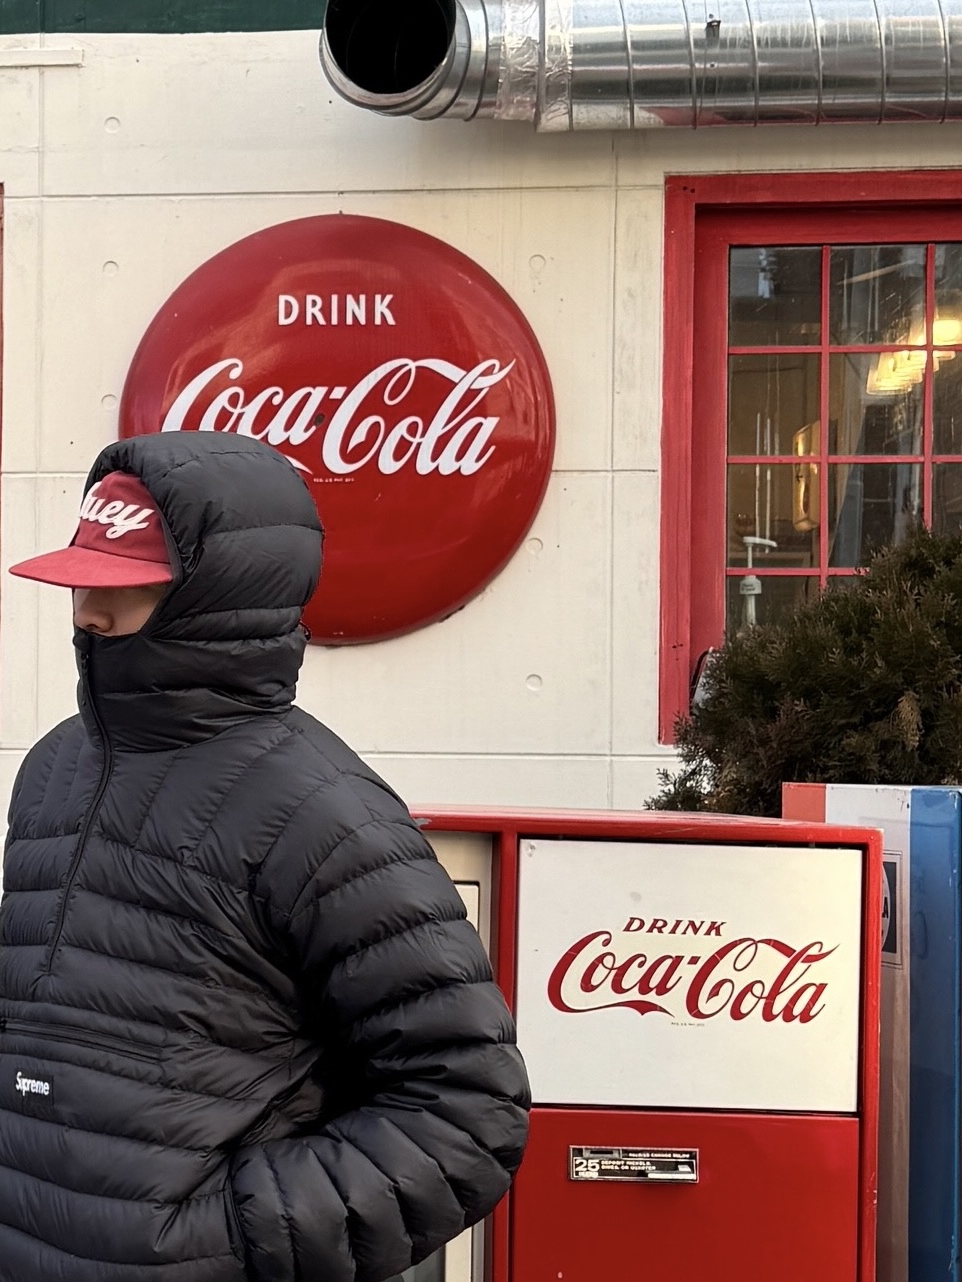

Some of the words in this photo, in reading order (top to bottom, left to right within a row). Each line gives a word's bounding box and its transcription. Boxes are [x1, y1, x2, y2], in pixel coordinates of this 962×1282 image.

[278, 294, 396, 325] DRINK
[161, 358, 516, 475] Coca-Cola
[623, 916, 727, 937] DRINK
[547, 930, 841, 1024] Coca-Cola
[15, 1071, 50, 1097] Supreme
[575, 1159, 600, 1172] 25
